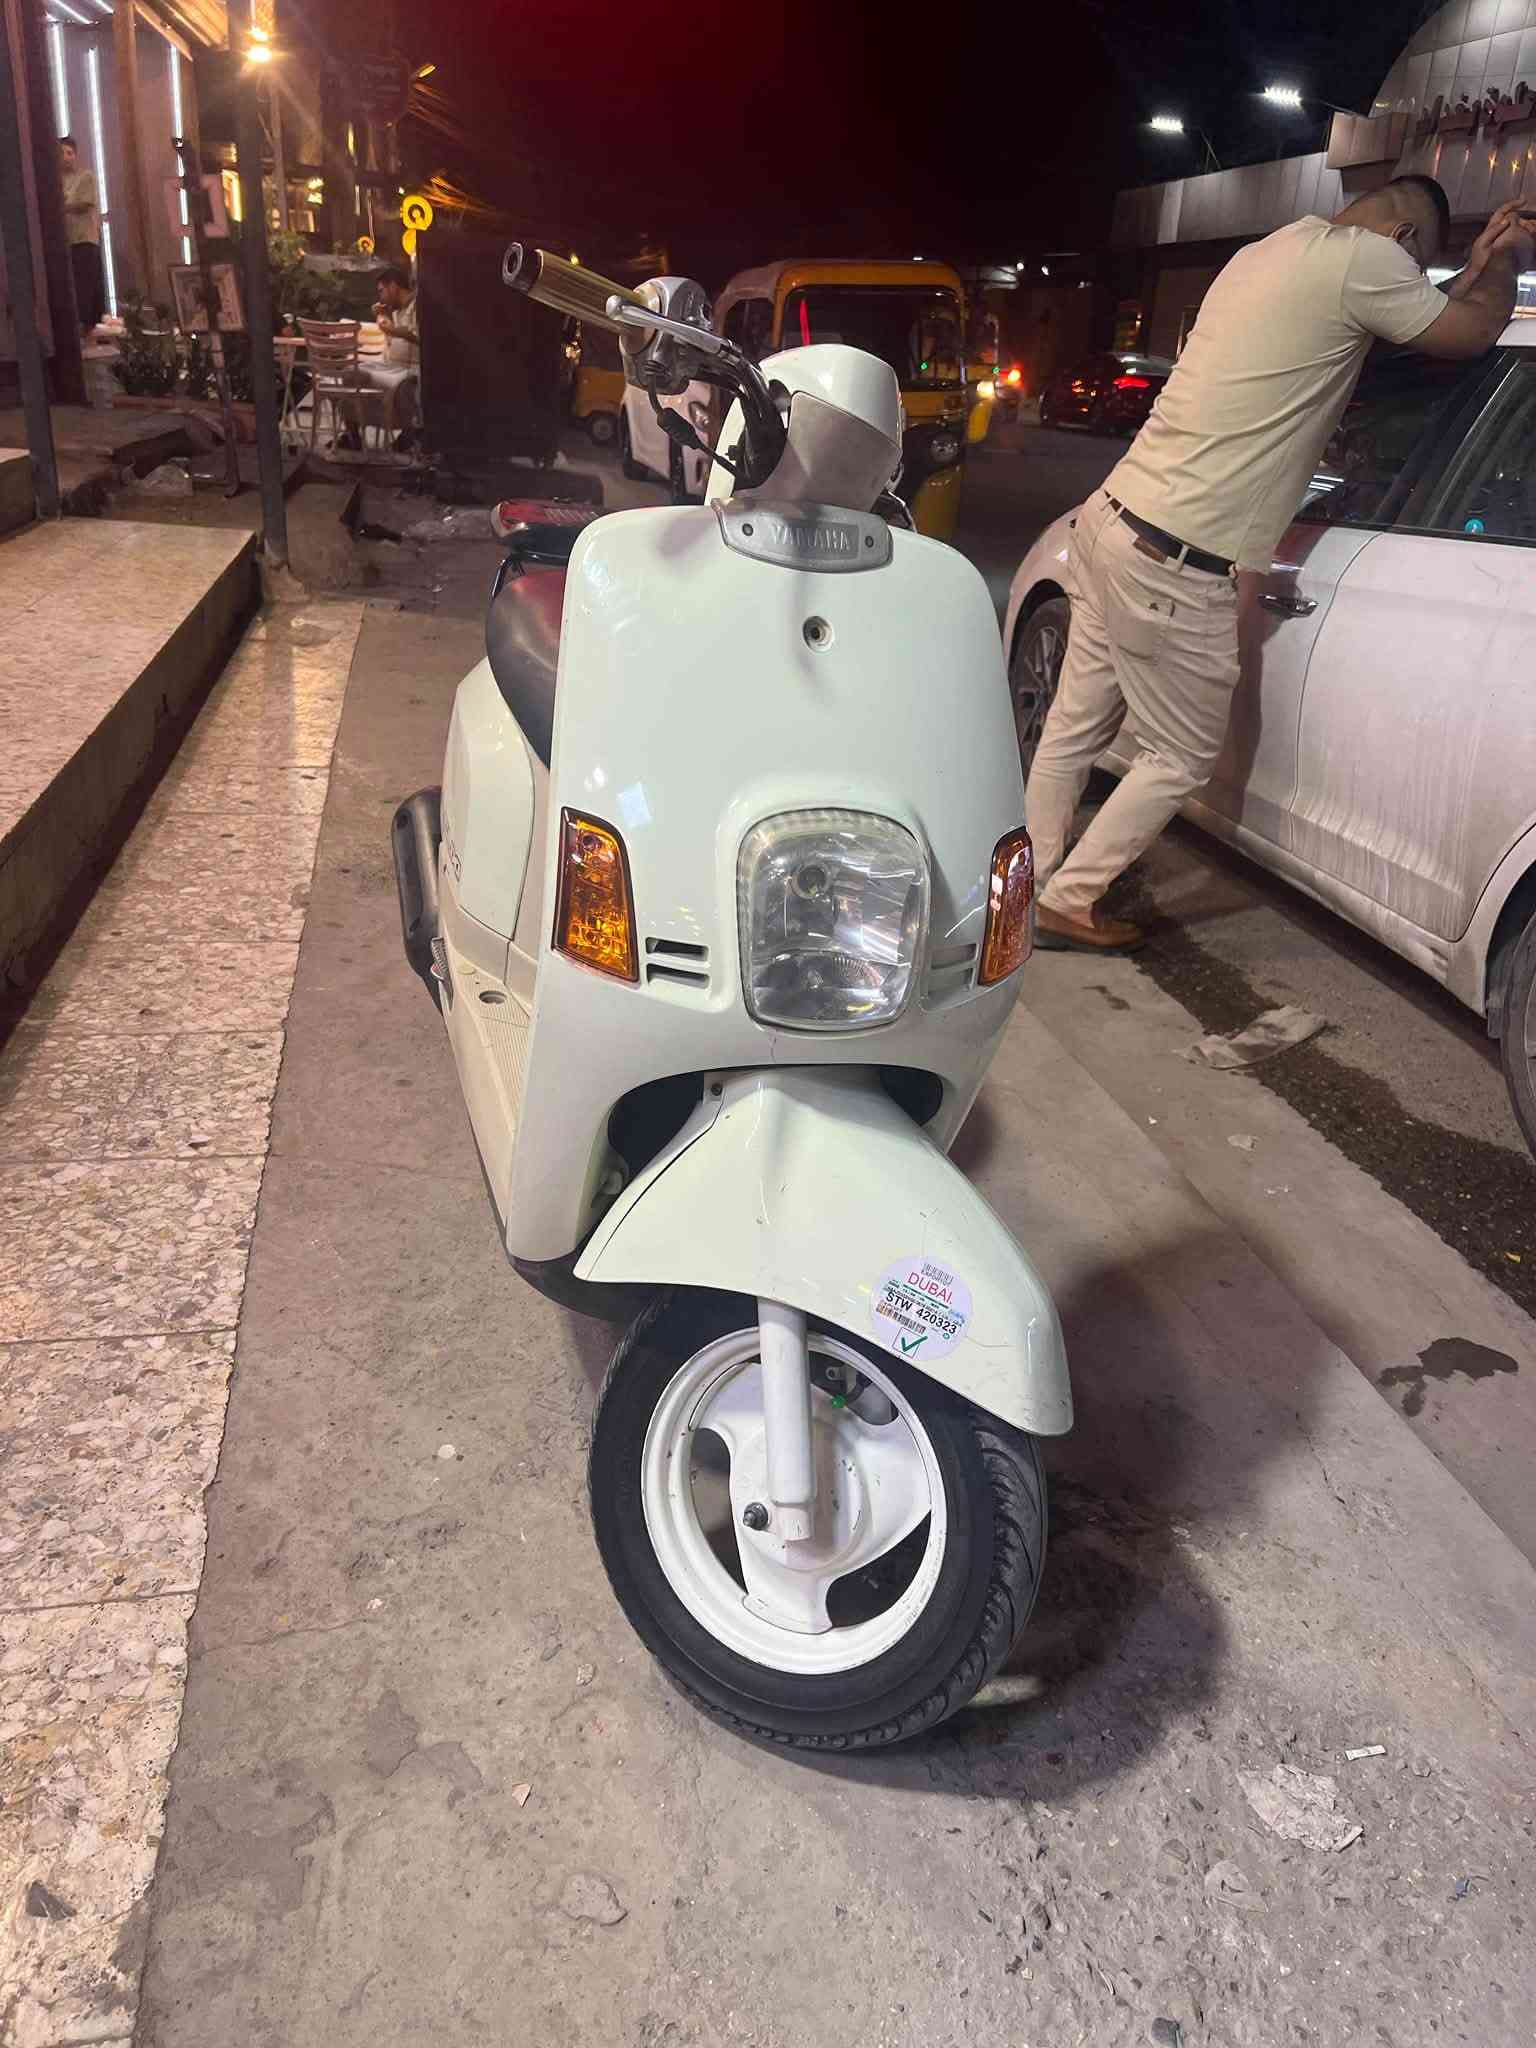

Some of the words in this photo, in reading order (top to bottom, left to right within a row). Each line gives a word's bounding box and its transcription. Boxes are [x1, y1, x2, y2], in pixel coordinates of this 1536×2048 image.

[908, 1272, 953, 1304] DUBAI
[886, 1291, 913, 1311] STW
[916, 1308, 957, 1334] 420323
